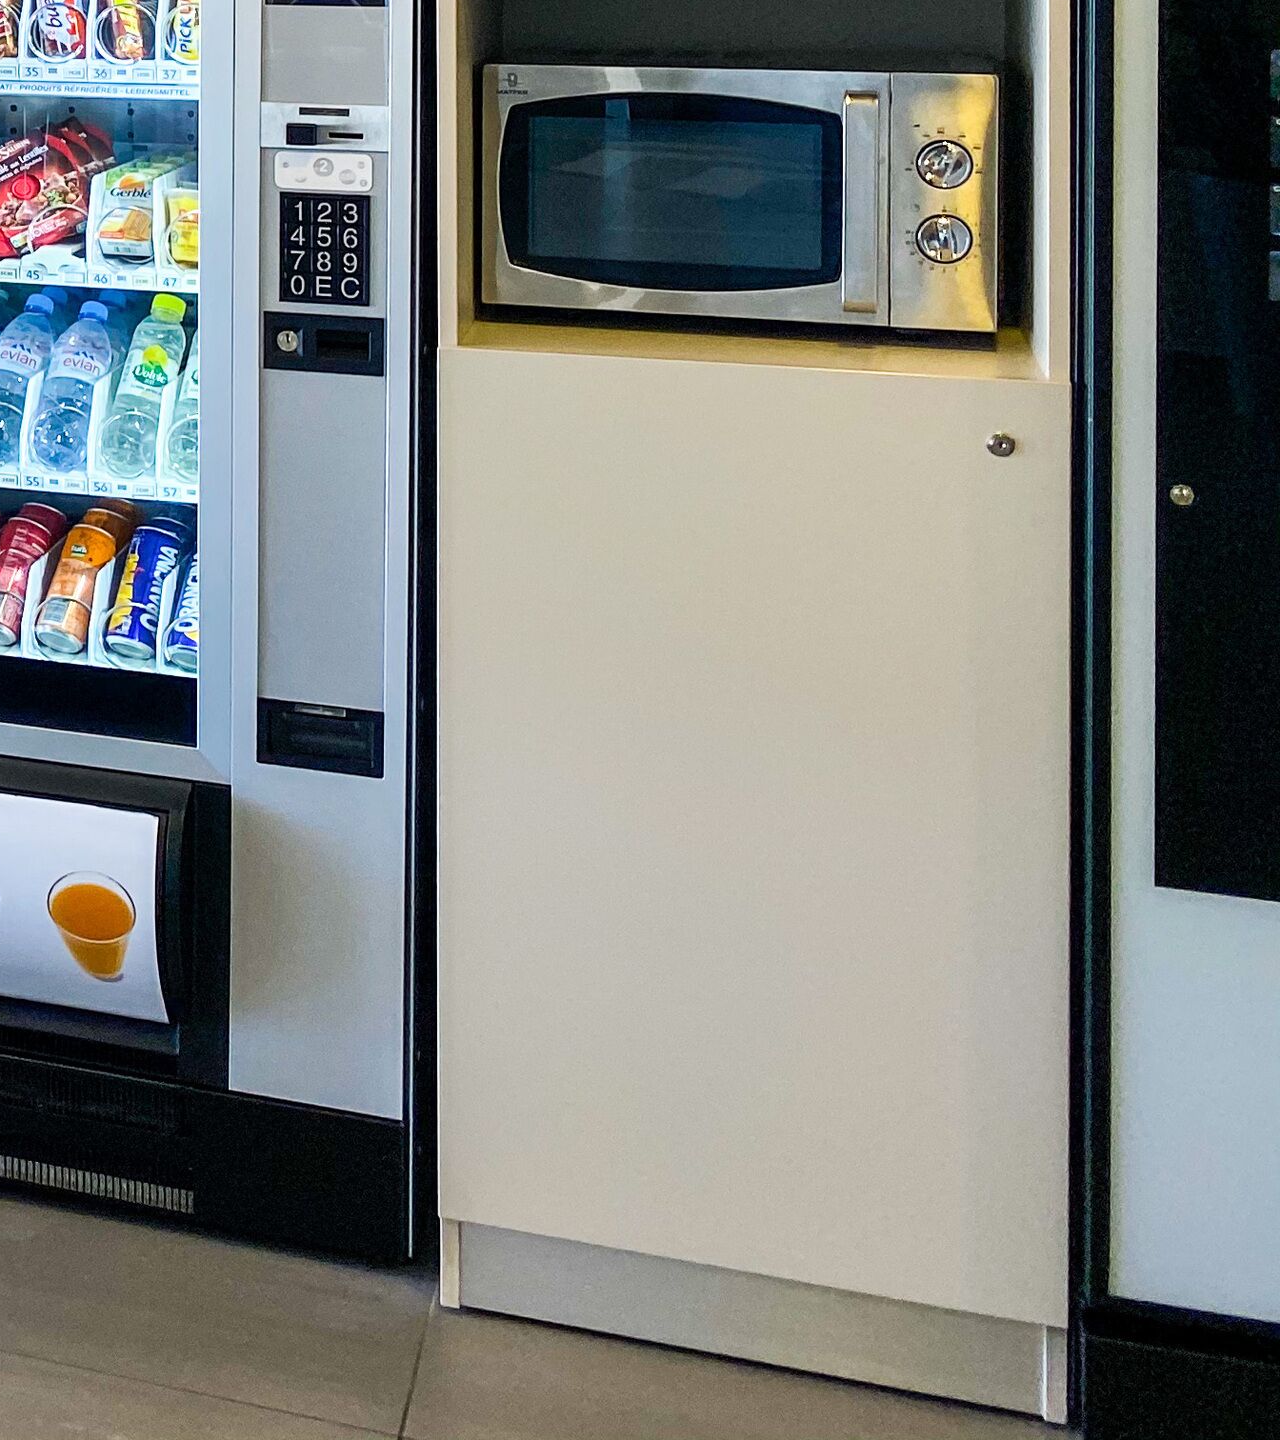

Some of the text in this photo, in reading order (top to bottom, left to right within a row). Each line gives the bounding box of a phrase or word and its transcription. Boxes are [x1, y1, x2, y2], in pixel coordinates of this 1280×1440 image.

[25, 67, 38, 76] 35
[94, 68, 107, 78] 36
[163, 69, 177, 79] 37
[20, 83, 61, 92] PRODUITS
[110, 187, 151, 198] Gerblé
[294, 200, 358, 223] 1 2 3
[290, 225, 358, 248] 4 5 6
[290, 250, 358, 273] 7 8 9
[26, 269, 40, 280] 45
[93, 274, 108, 284] 46
[162, 277, 177, 287] 47
[290, 275, 359, 298] 0 E C
[0, 349, 37, 369] evian
[63, 356, 100, 375] evian
[26, 476, 40, 486] 55
[93, 482, 108, 492] 56
[163, 487, 177, 497] 57
